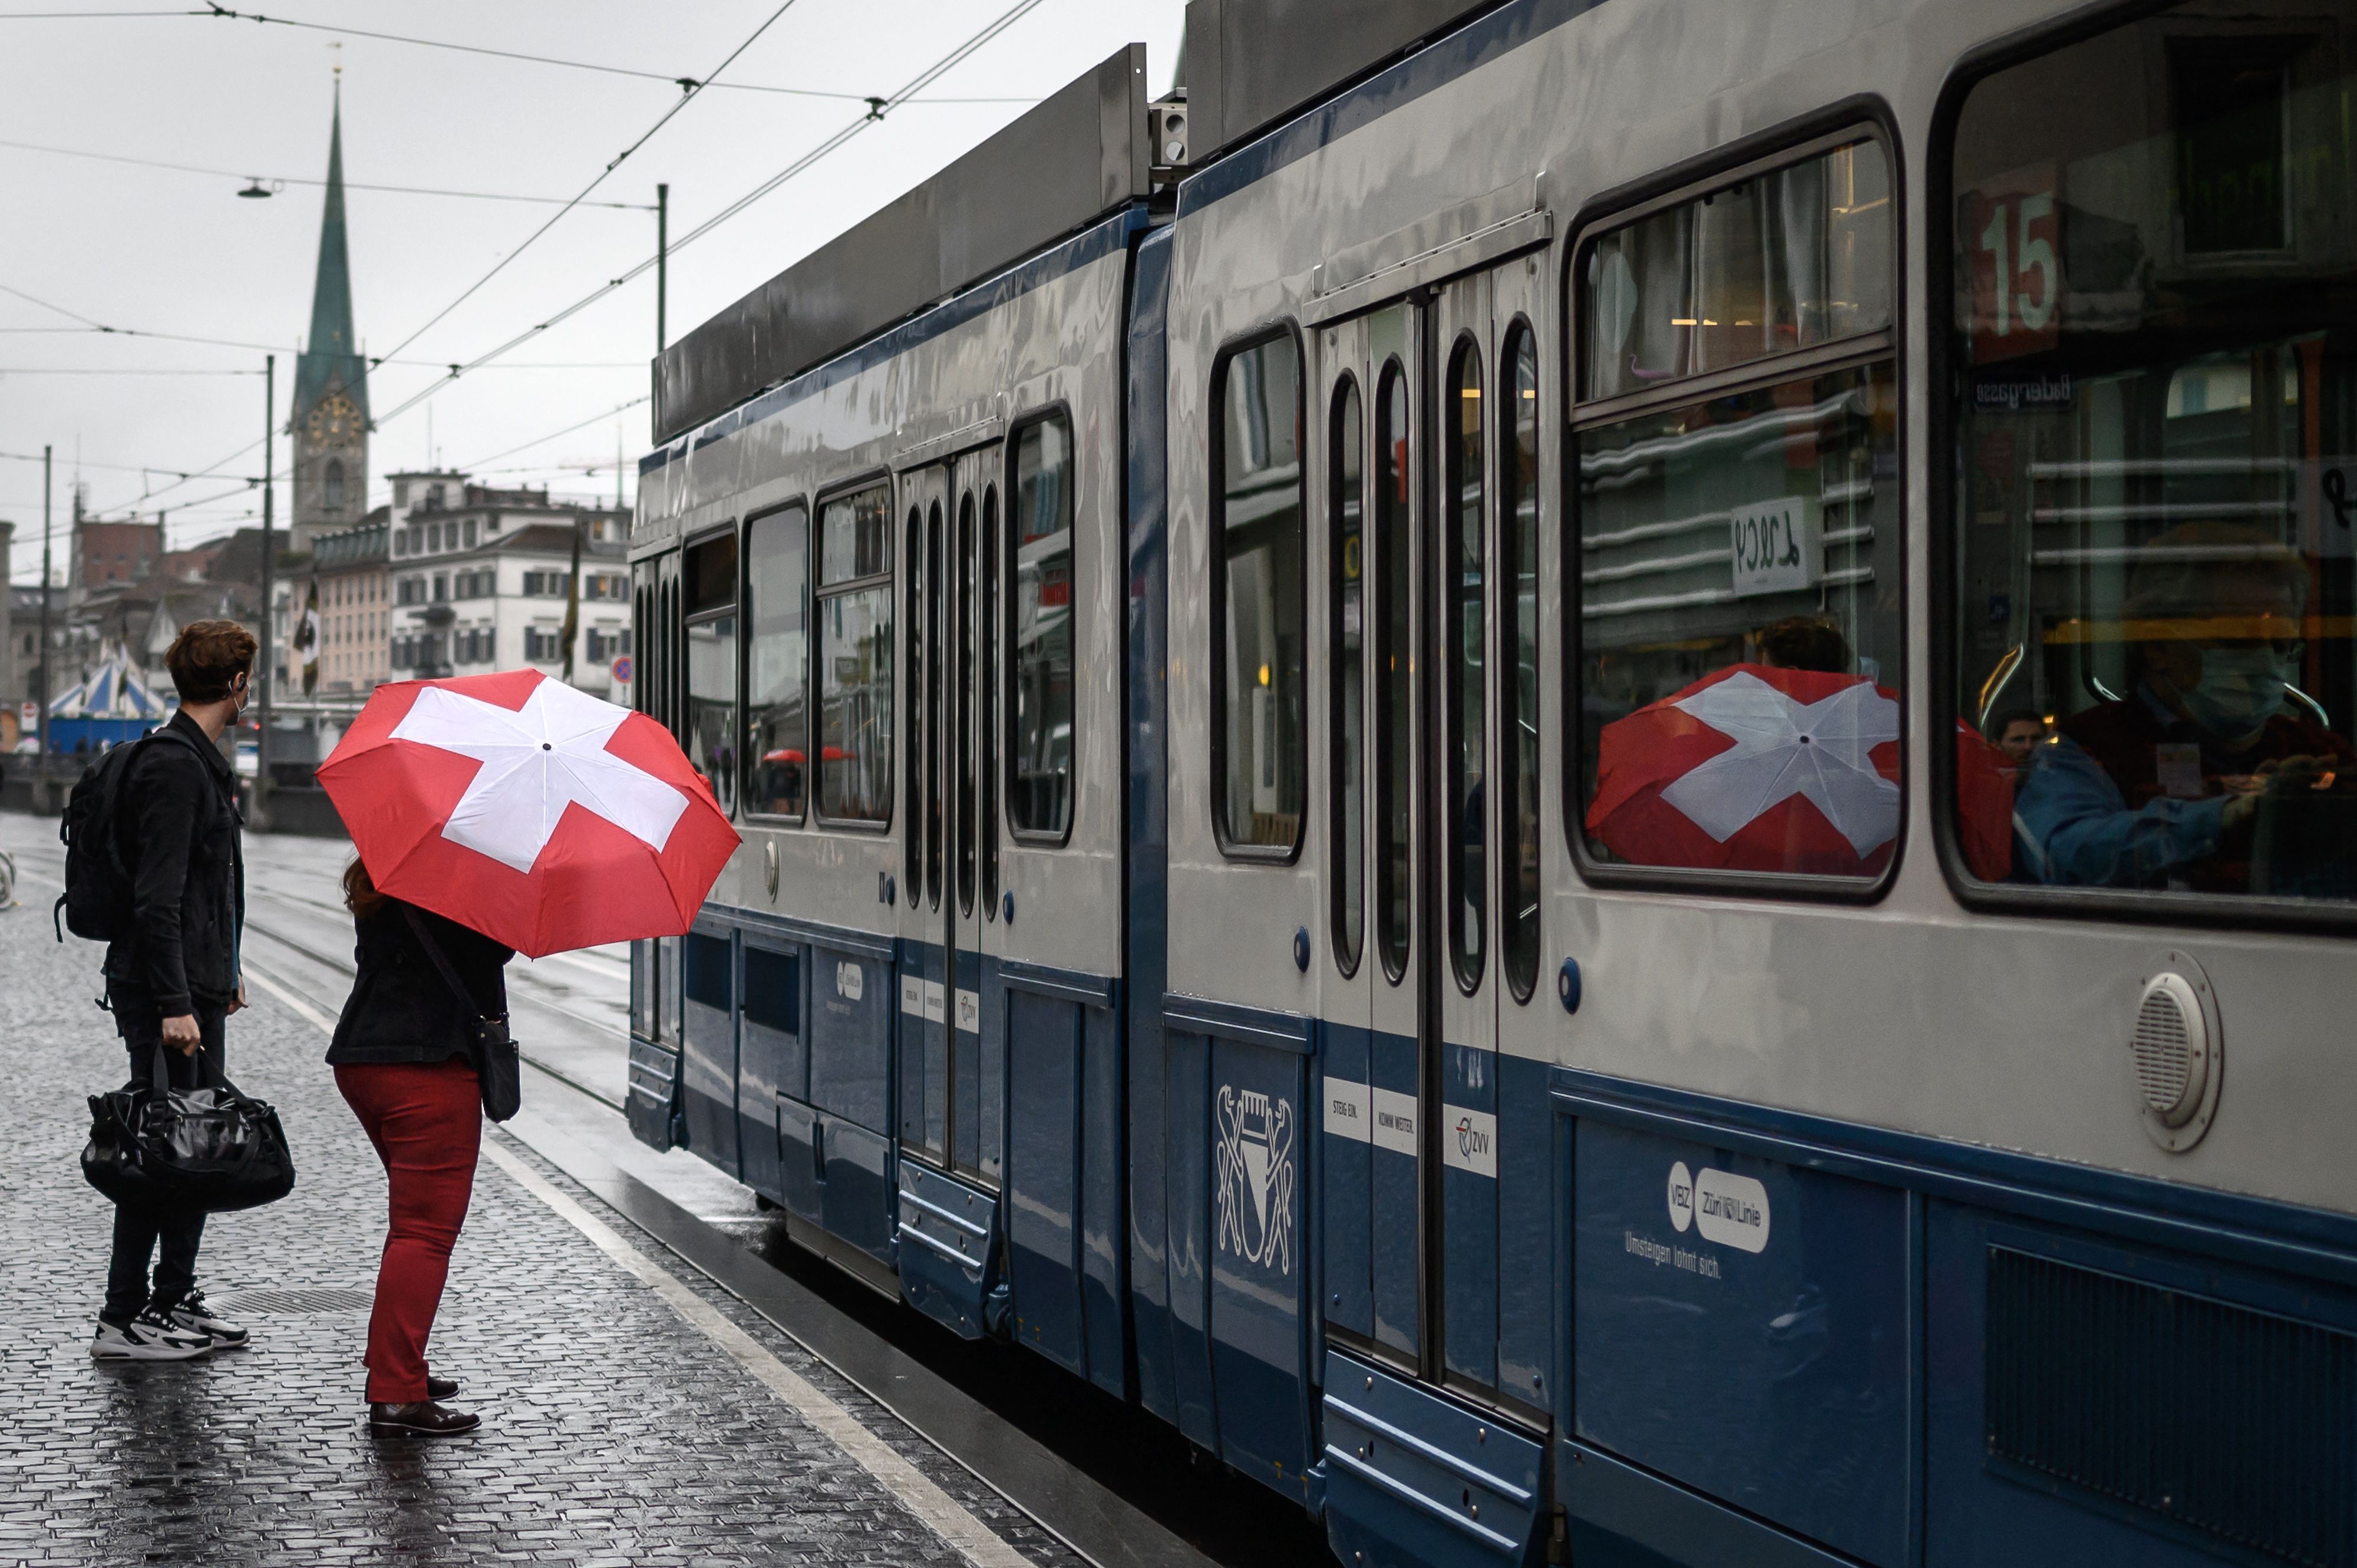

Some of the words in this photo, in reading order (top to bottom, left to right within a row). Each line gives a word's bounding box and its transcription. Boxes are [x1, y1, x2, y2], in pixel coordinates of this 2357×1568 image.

[1982, 192, 2057, 336] 15
[1332, 1100, 1347, 1116] STEIG
[1473, 1130, 1489, 1156] ZVV
[1671, 1183, 1691, 1209] VBZ
[1702, 1191, 1721, 1216] Züri
[1737, 1199, 1761, 1227] Linie
[1625, 1231, 1671, 1266] Umsteigen
[1674, 1244, 1696, 1272] lohnt
[1699, 1253, 1721, 1280] sich.
